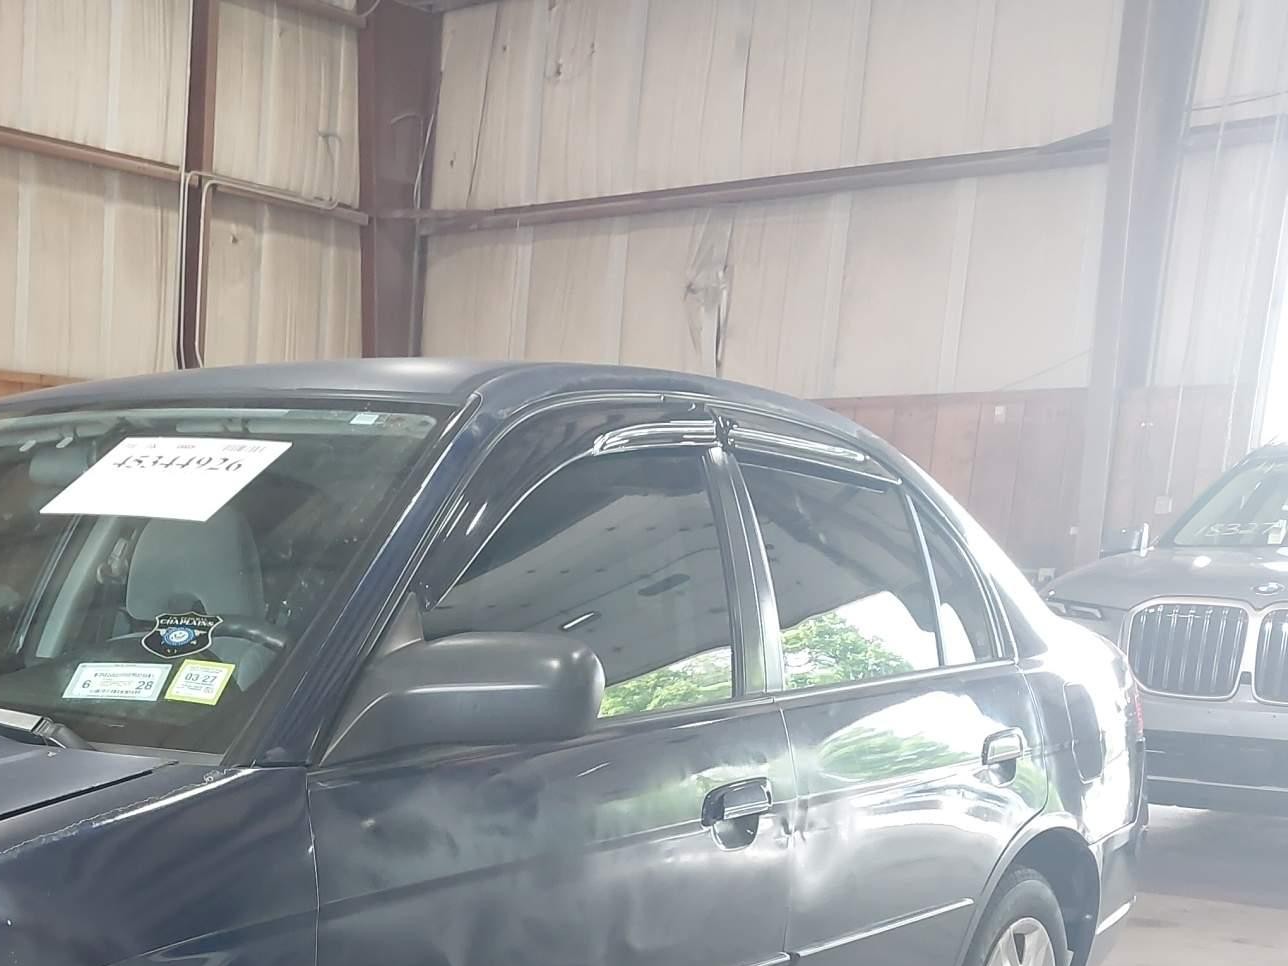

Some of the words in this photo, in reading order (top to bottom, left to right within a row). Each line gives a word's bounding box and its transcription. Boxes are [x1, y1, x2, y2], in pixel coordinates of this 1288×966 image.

[113, 454, 245, 472] 45344926
[184, 672, 200, 682] 03
[201, 674, 218, 683] 27
[81, 679, 92, 689] 6
[134, 680, 154, 690] 28
